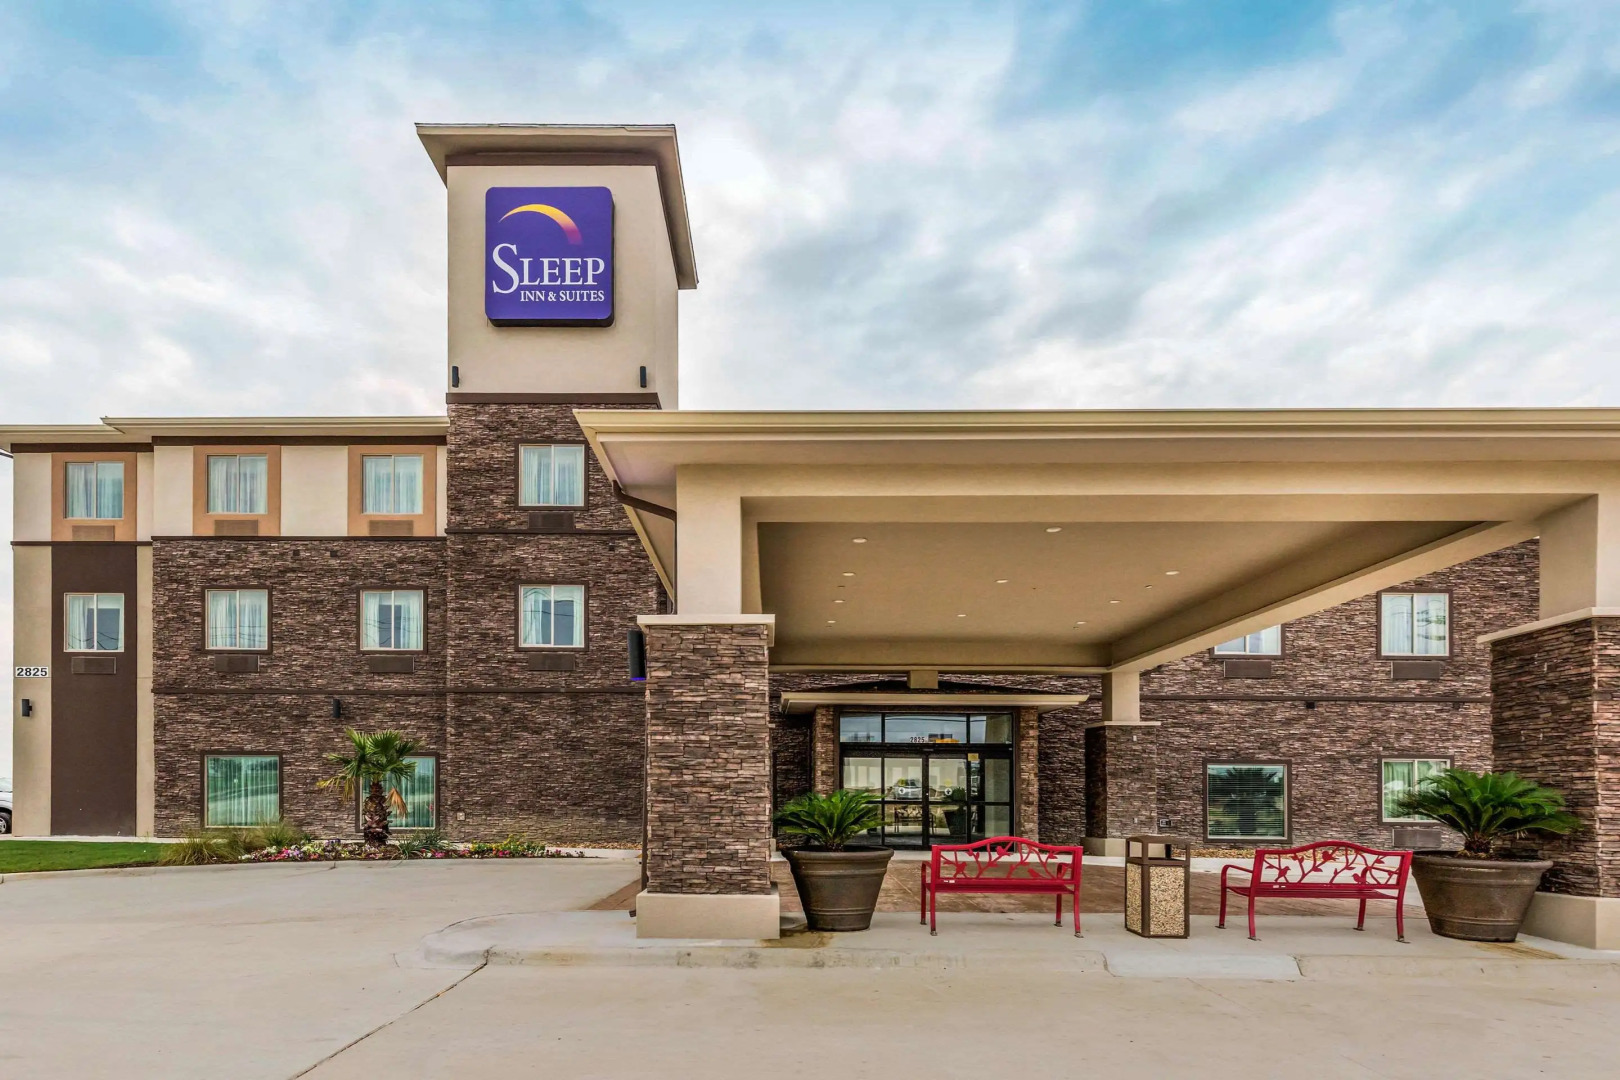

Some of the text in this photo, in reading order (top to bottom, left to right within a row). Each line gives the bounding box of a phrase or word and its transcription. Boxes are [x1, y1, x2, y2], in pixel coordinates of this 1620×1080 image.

[492, 243, 605, 294] SLEEP
[520, 290, 605, 301] INN & SUITES
[16, 667, 48, 677] 2825
